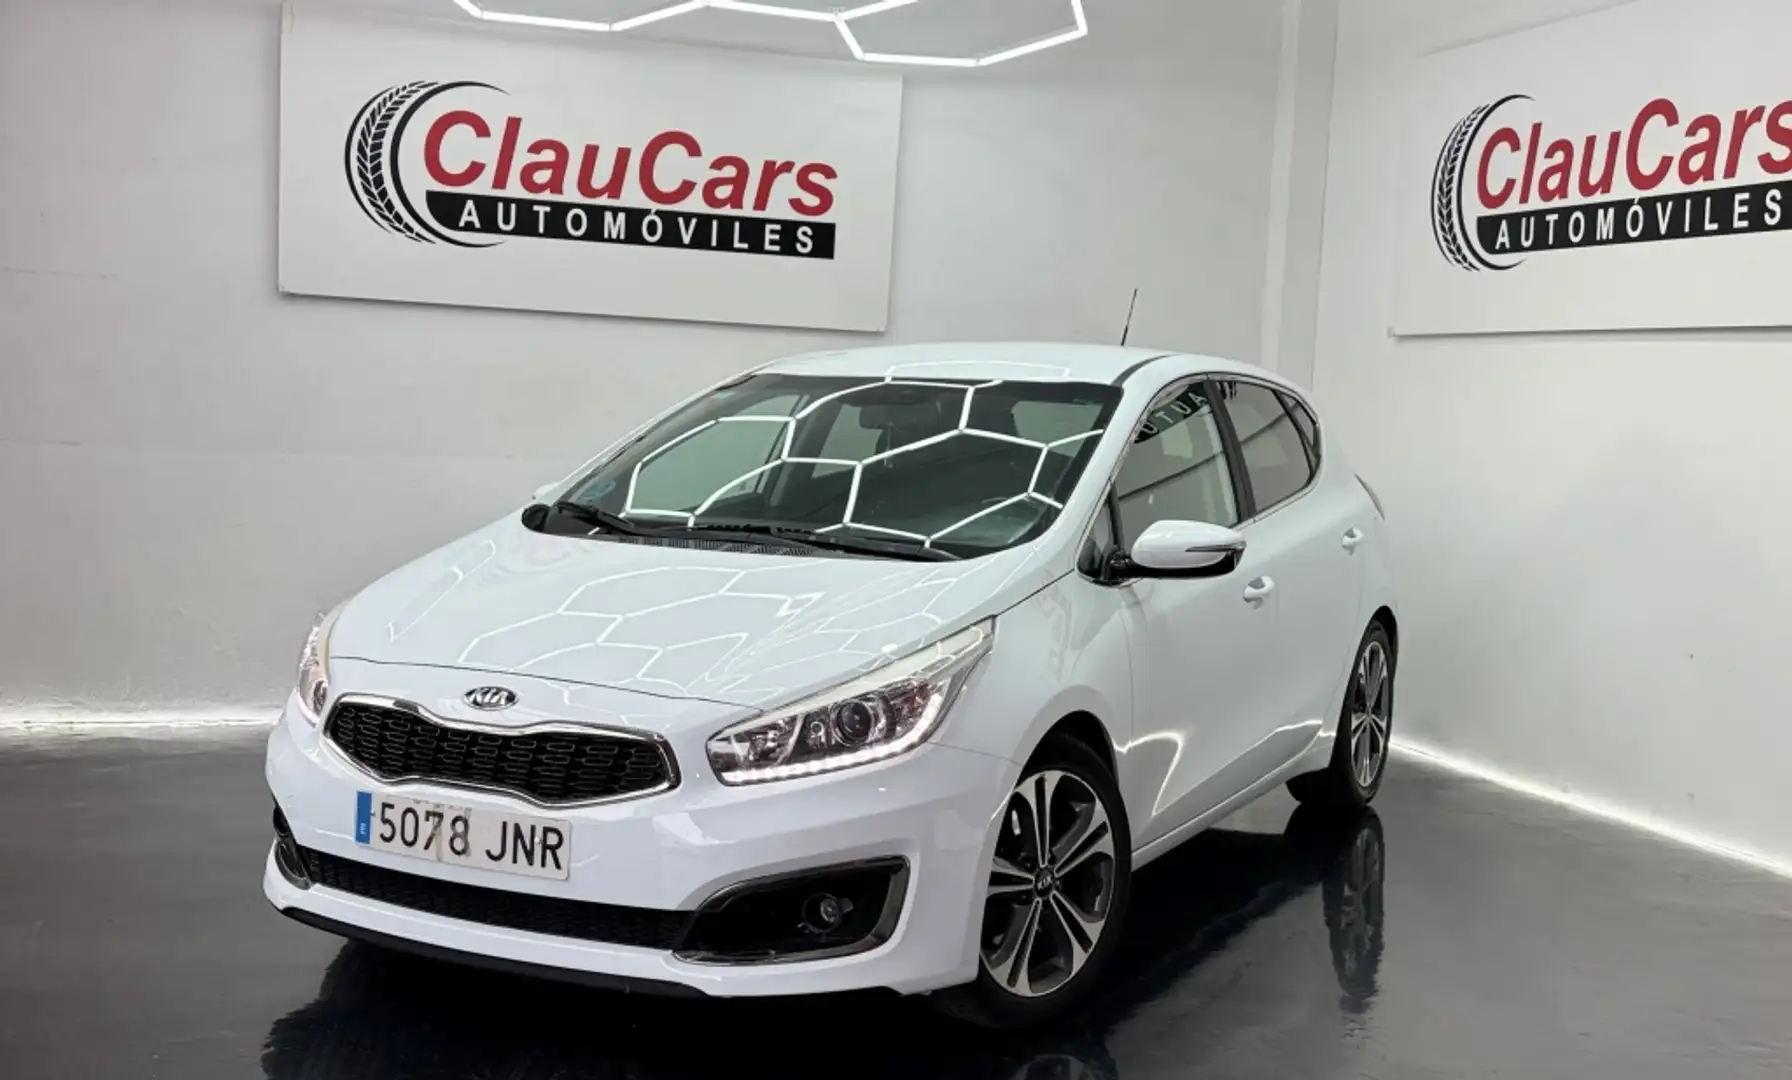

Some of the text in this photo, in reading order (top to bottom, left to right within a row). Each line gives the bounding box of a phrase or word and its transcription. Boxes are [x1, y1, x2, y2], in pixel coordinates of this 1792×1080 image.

[423, 110, 838, 216] ClauCars
[1477, 98, 1792, 209] ClauCars
[458, 200, 814, 254] AUTOMÓVILES
[1495, 188, 1782, 249] AUTOMÓVILES
[467, 687, 511, 706] KIA
[379, 802, 564, 870] 5078 JNR
